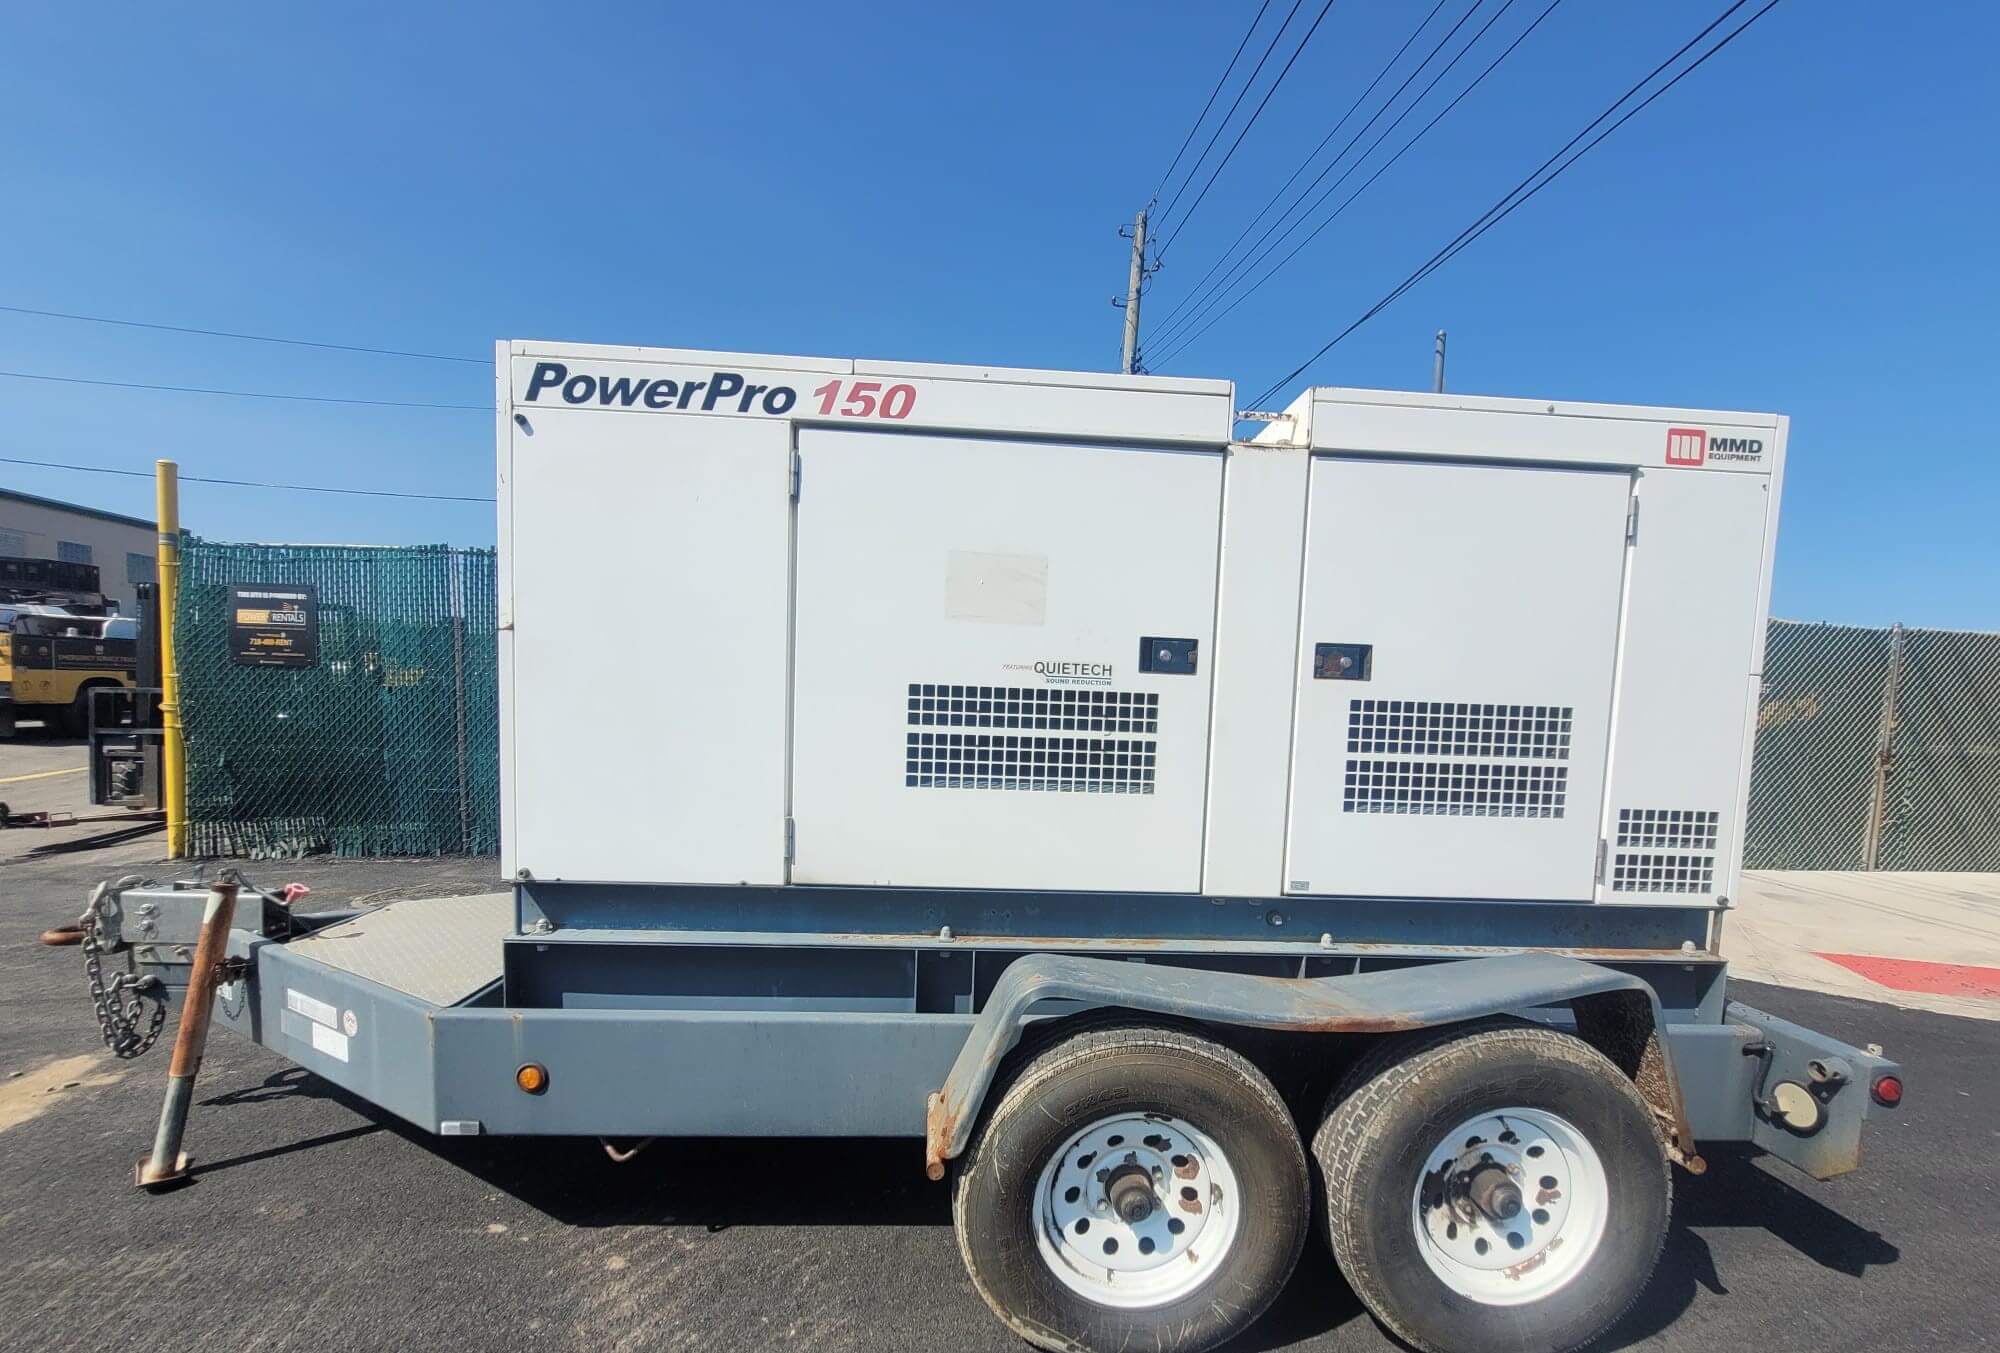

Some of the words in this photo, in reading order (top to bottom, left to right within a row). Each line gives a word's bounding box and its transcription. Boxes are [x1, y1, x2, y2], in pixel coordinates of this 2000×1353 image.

[524, 362, 797, 415] PowerPro
[813, 379, 917, 420] 150
[1709, 437, 1763, 454] MMD
[1708, 452, 1762, 462] EQUIPMENT
[272, 613, 304, 623] RENTALS
[1034, 661, 1113, 677] QUIETECH
